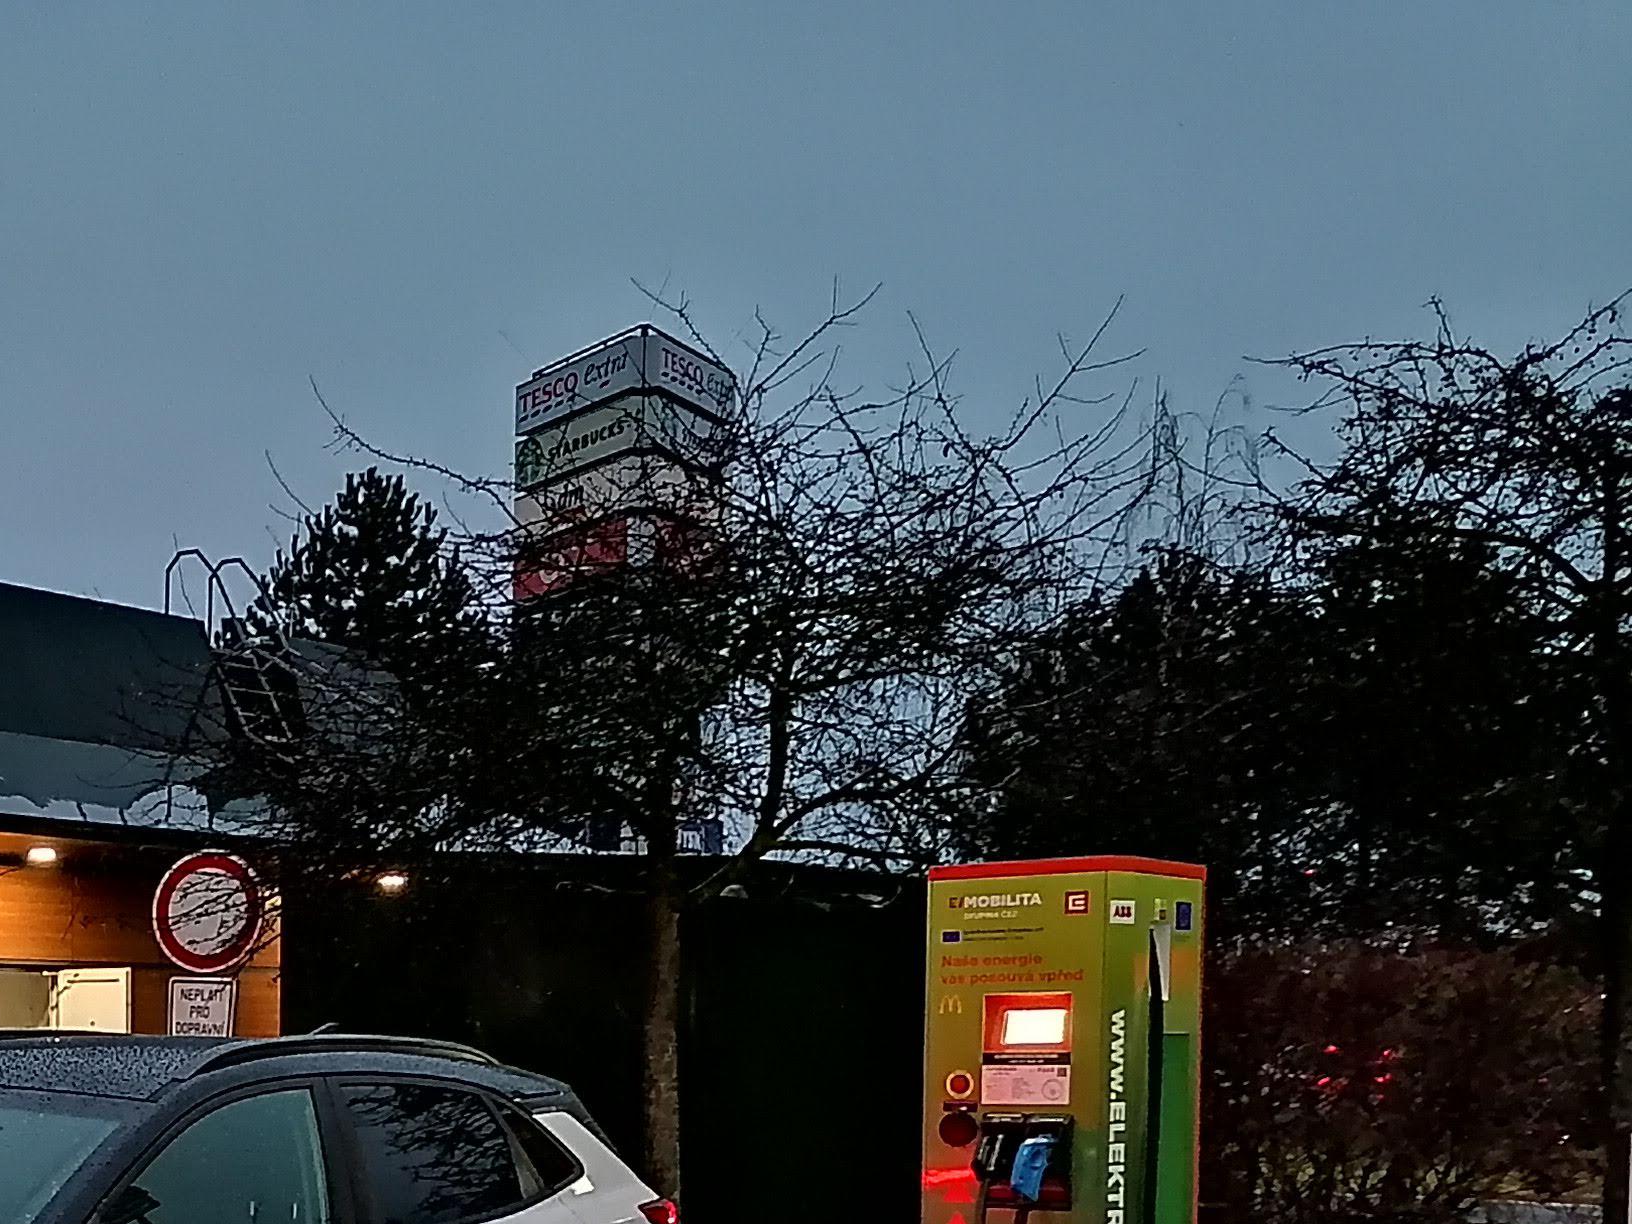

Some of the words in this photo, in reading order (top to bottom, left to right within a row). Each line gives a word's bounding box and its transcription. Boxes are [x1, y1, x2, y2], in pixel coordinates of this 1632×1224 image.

[662, 348, 704, 385] TESCO
[519, 371, 579, 413] TESCO
[548, 419, 626, 460] STARBUCKS
[1113, 905, 1132, 918] ABB
[983, 953, 1042, 968] energie
[190, 1005, 210, 1018] PRO
